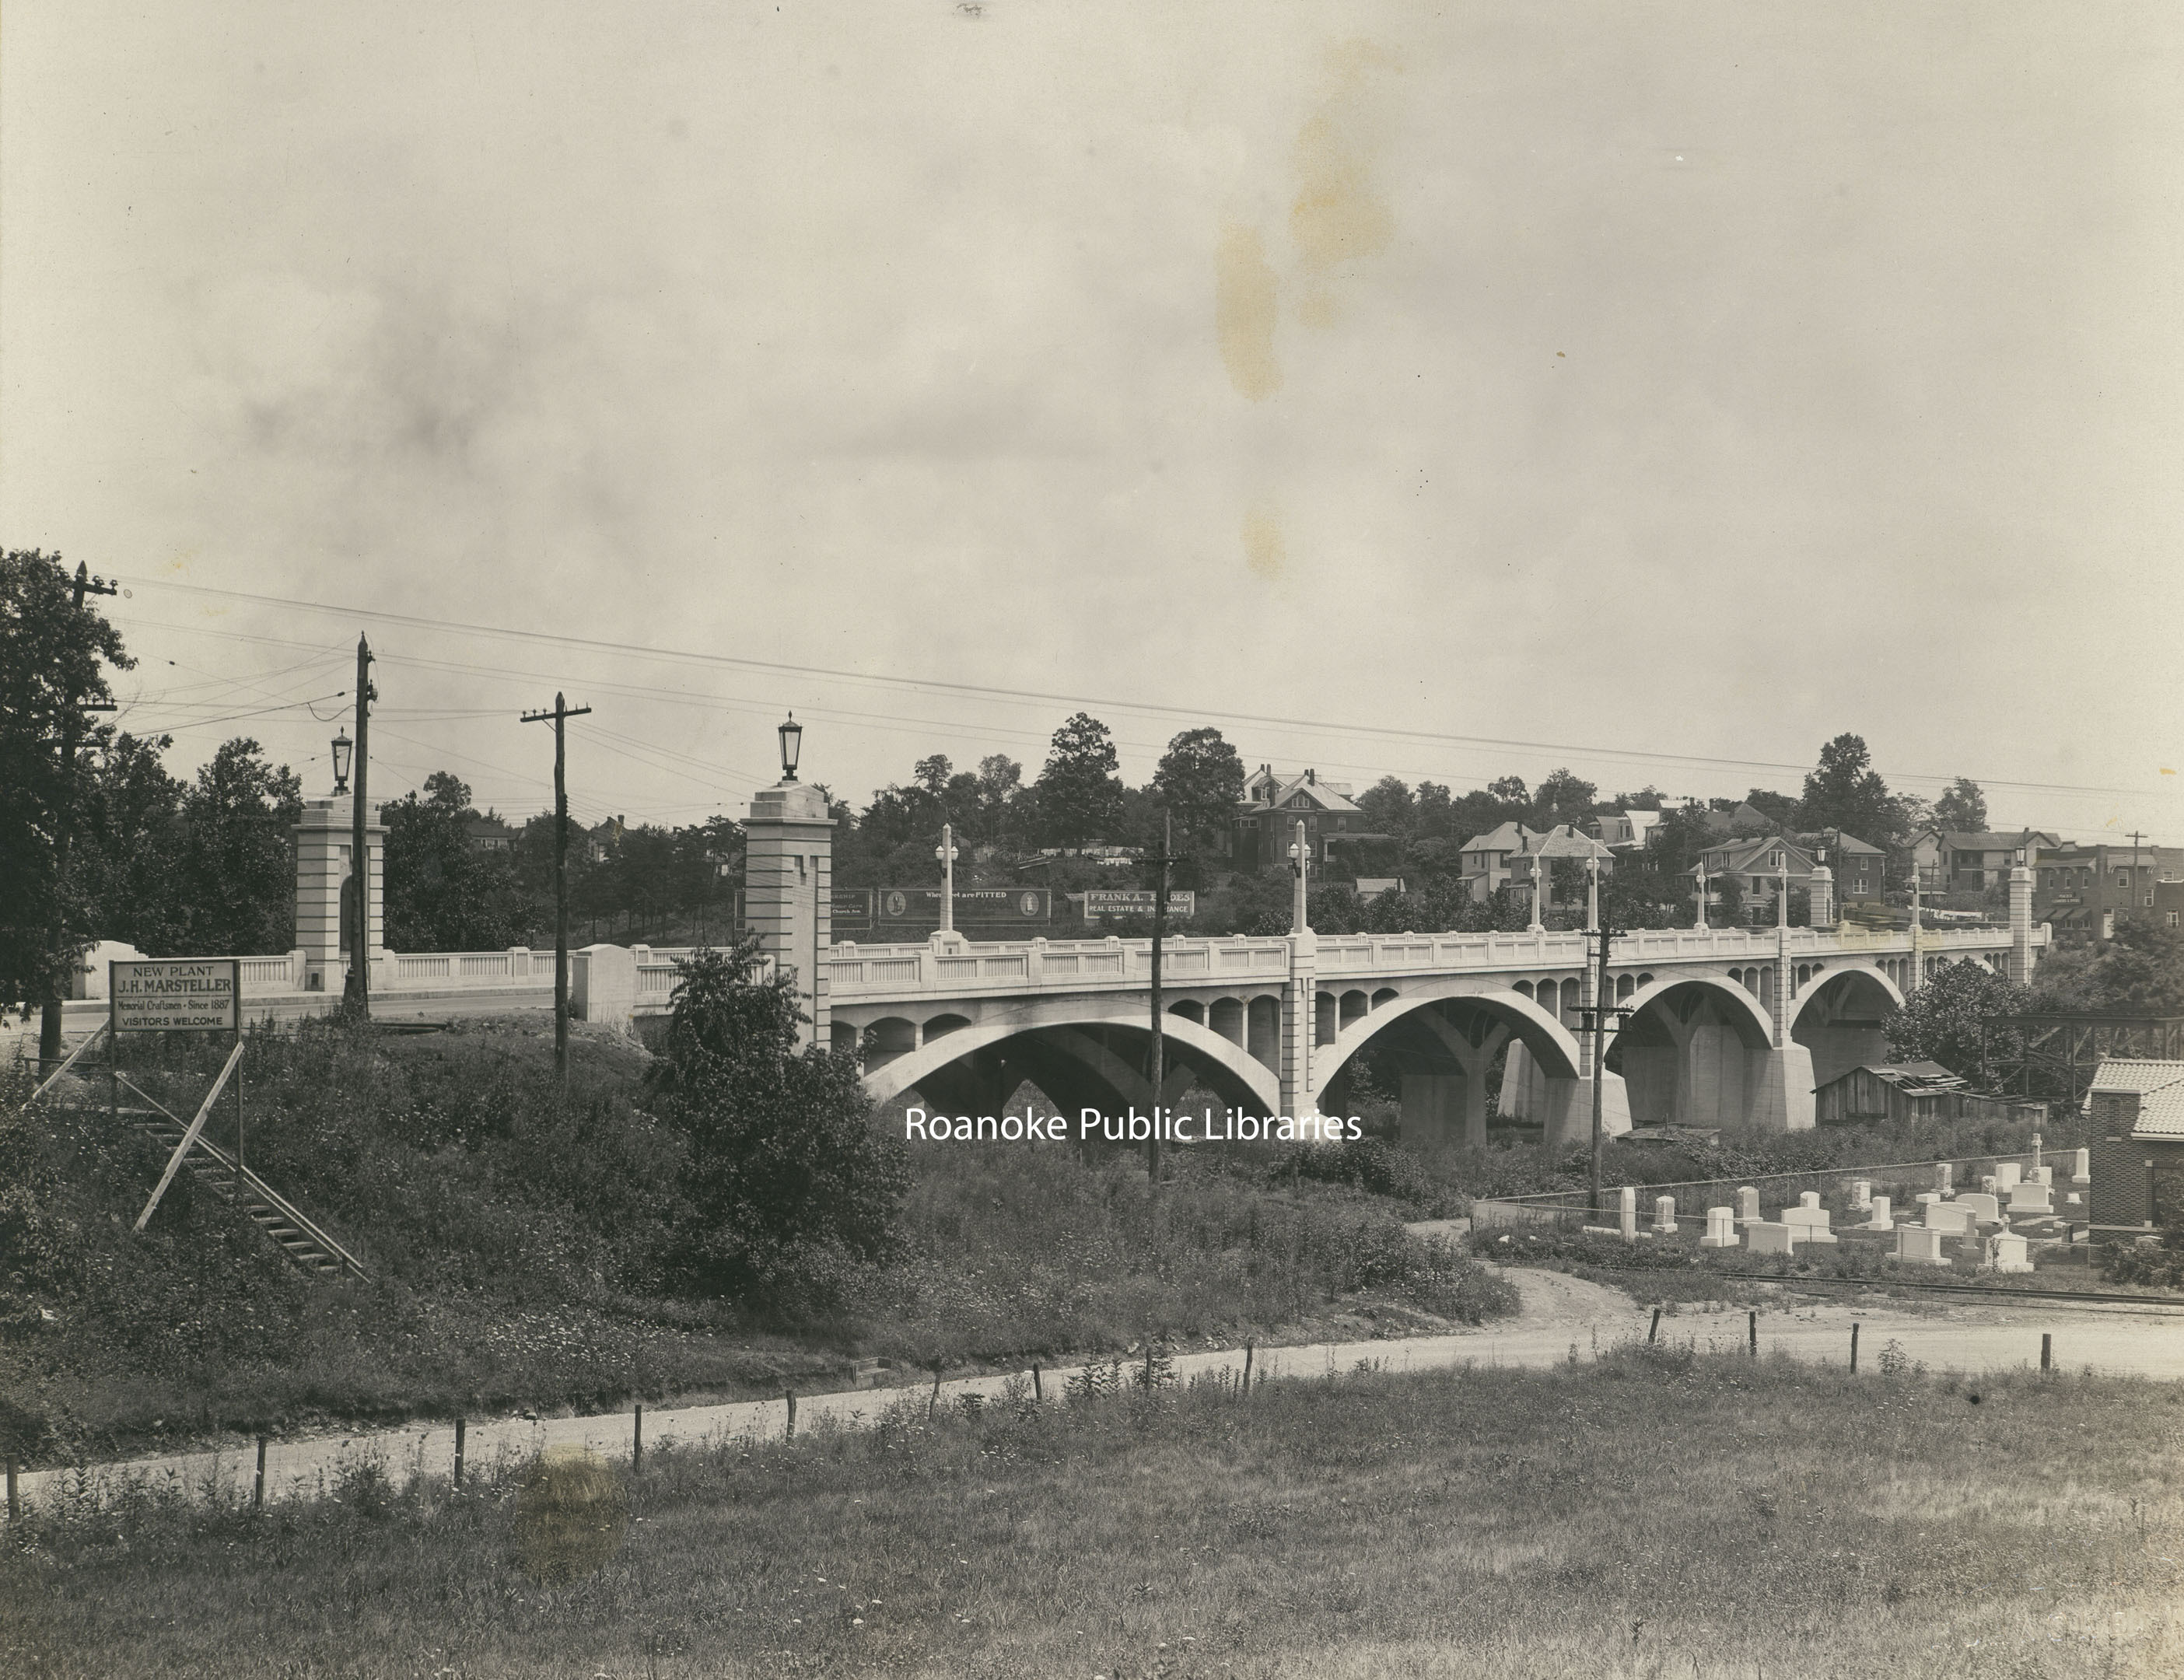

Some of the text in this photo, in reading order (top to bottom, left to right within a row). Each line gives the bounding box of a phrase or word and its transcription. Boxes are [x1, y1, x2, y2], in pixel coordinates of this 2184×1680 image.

[1090, 893, 1131, 901] FRANK
[1132, 893, 1143, 901] A.
[133, 966, 214, 977] NEW PLANT
[117, 999, 229, 1011] Memorial Craftsmen Since 1887
[122, 1017, 223, 1026] VISITORS WELCOME
